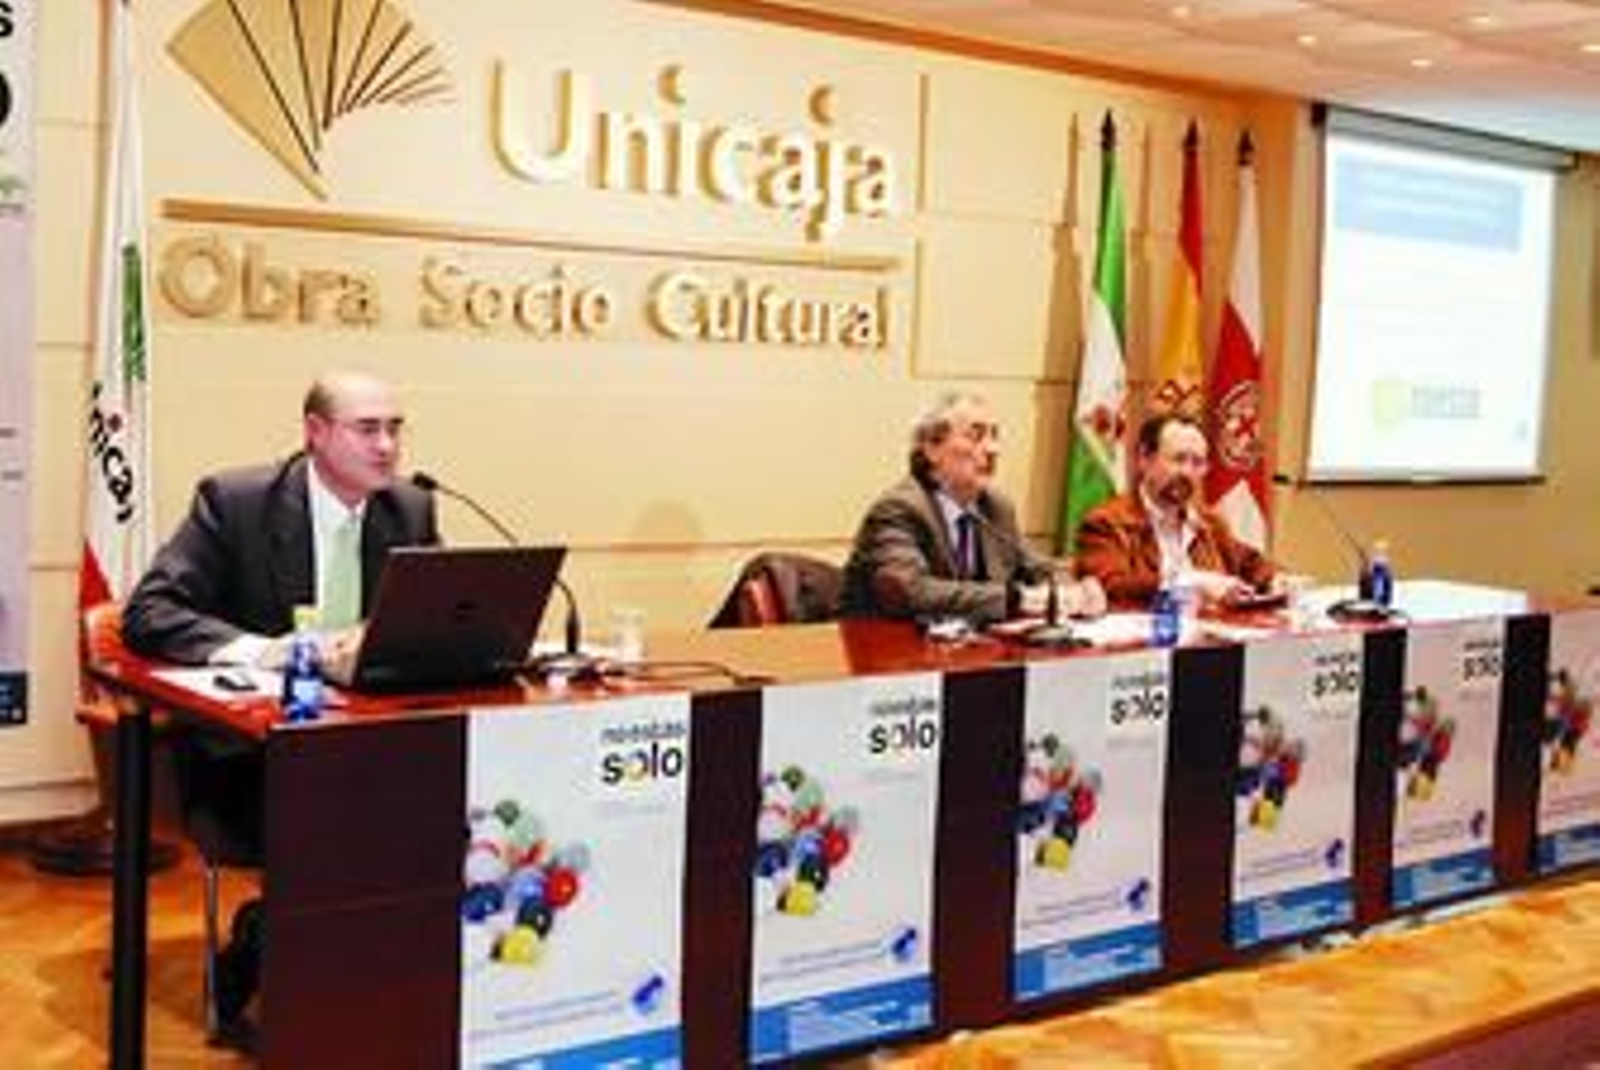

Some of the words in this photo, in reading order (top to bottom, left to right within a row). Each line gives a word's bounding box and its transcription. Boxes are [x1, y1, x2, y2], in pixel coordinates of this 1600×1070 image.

[489, 60, 895, 242] Unicaja
[158, 234, 380, 325] Obra
[419, 255, 613, 335] Socio
[645, 270, 890, 347] Cultural
[602, 742, 683, 785] solo
[870, 717, 937, 754] solo
